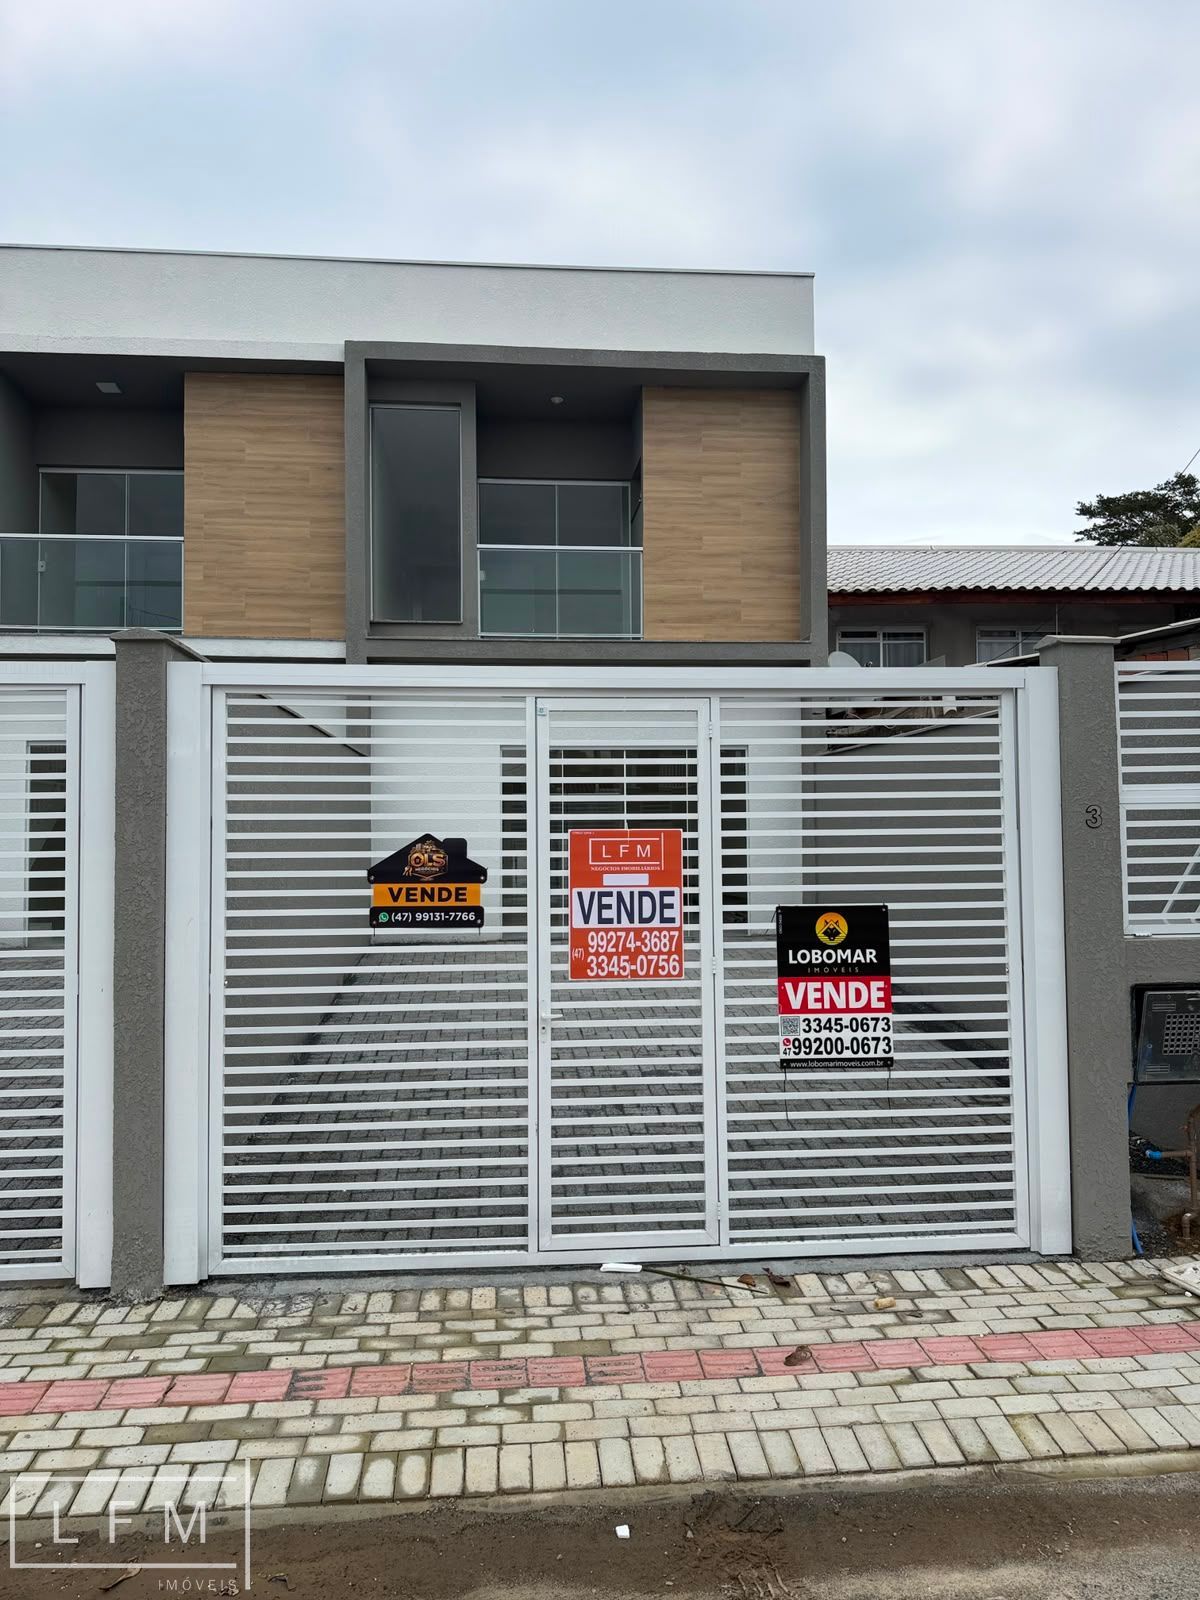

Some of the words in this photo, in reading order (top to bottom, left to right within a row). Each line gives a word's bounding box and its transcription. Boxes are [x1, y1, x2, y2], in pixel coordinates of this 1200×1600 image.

[1085, 804, 1102, 829] 3
[410, 852, 446, 867] OLS
[388, 887, 468, 902] VENDE
[577, 890, 676, 925] VENDE
[391, 912, 412, 922] (47)
[415, 912, 476, 921] 99131-7766
[587, 930, 680, 953] 99274-3687
[571, 948, 585, 961] (47)
[788, 949, 878, 964] LOBOMAR
[586, 955, 680, 976] 3345-0756
[807, 966, 860, 974] IMÓVEIS
[784, 981, 886, 1010] VENDE
[801, 1017, 891, 1034] 3345-0673
[782, 1048, 791, 1057] 47
[792, 1036, 892, 1056] 99200-0673
[790, 1060, 884, 1068] www.lobomarimoveis.com.br
